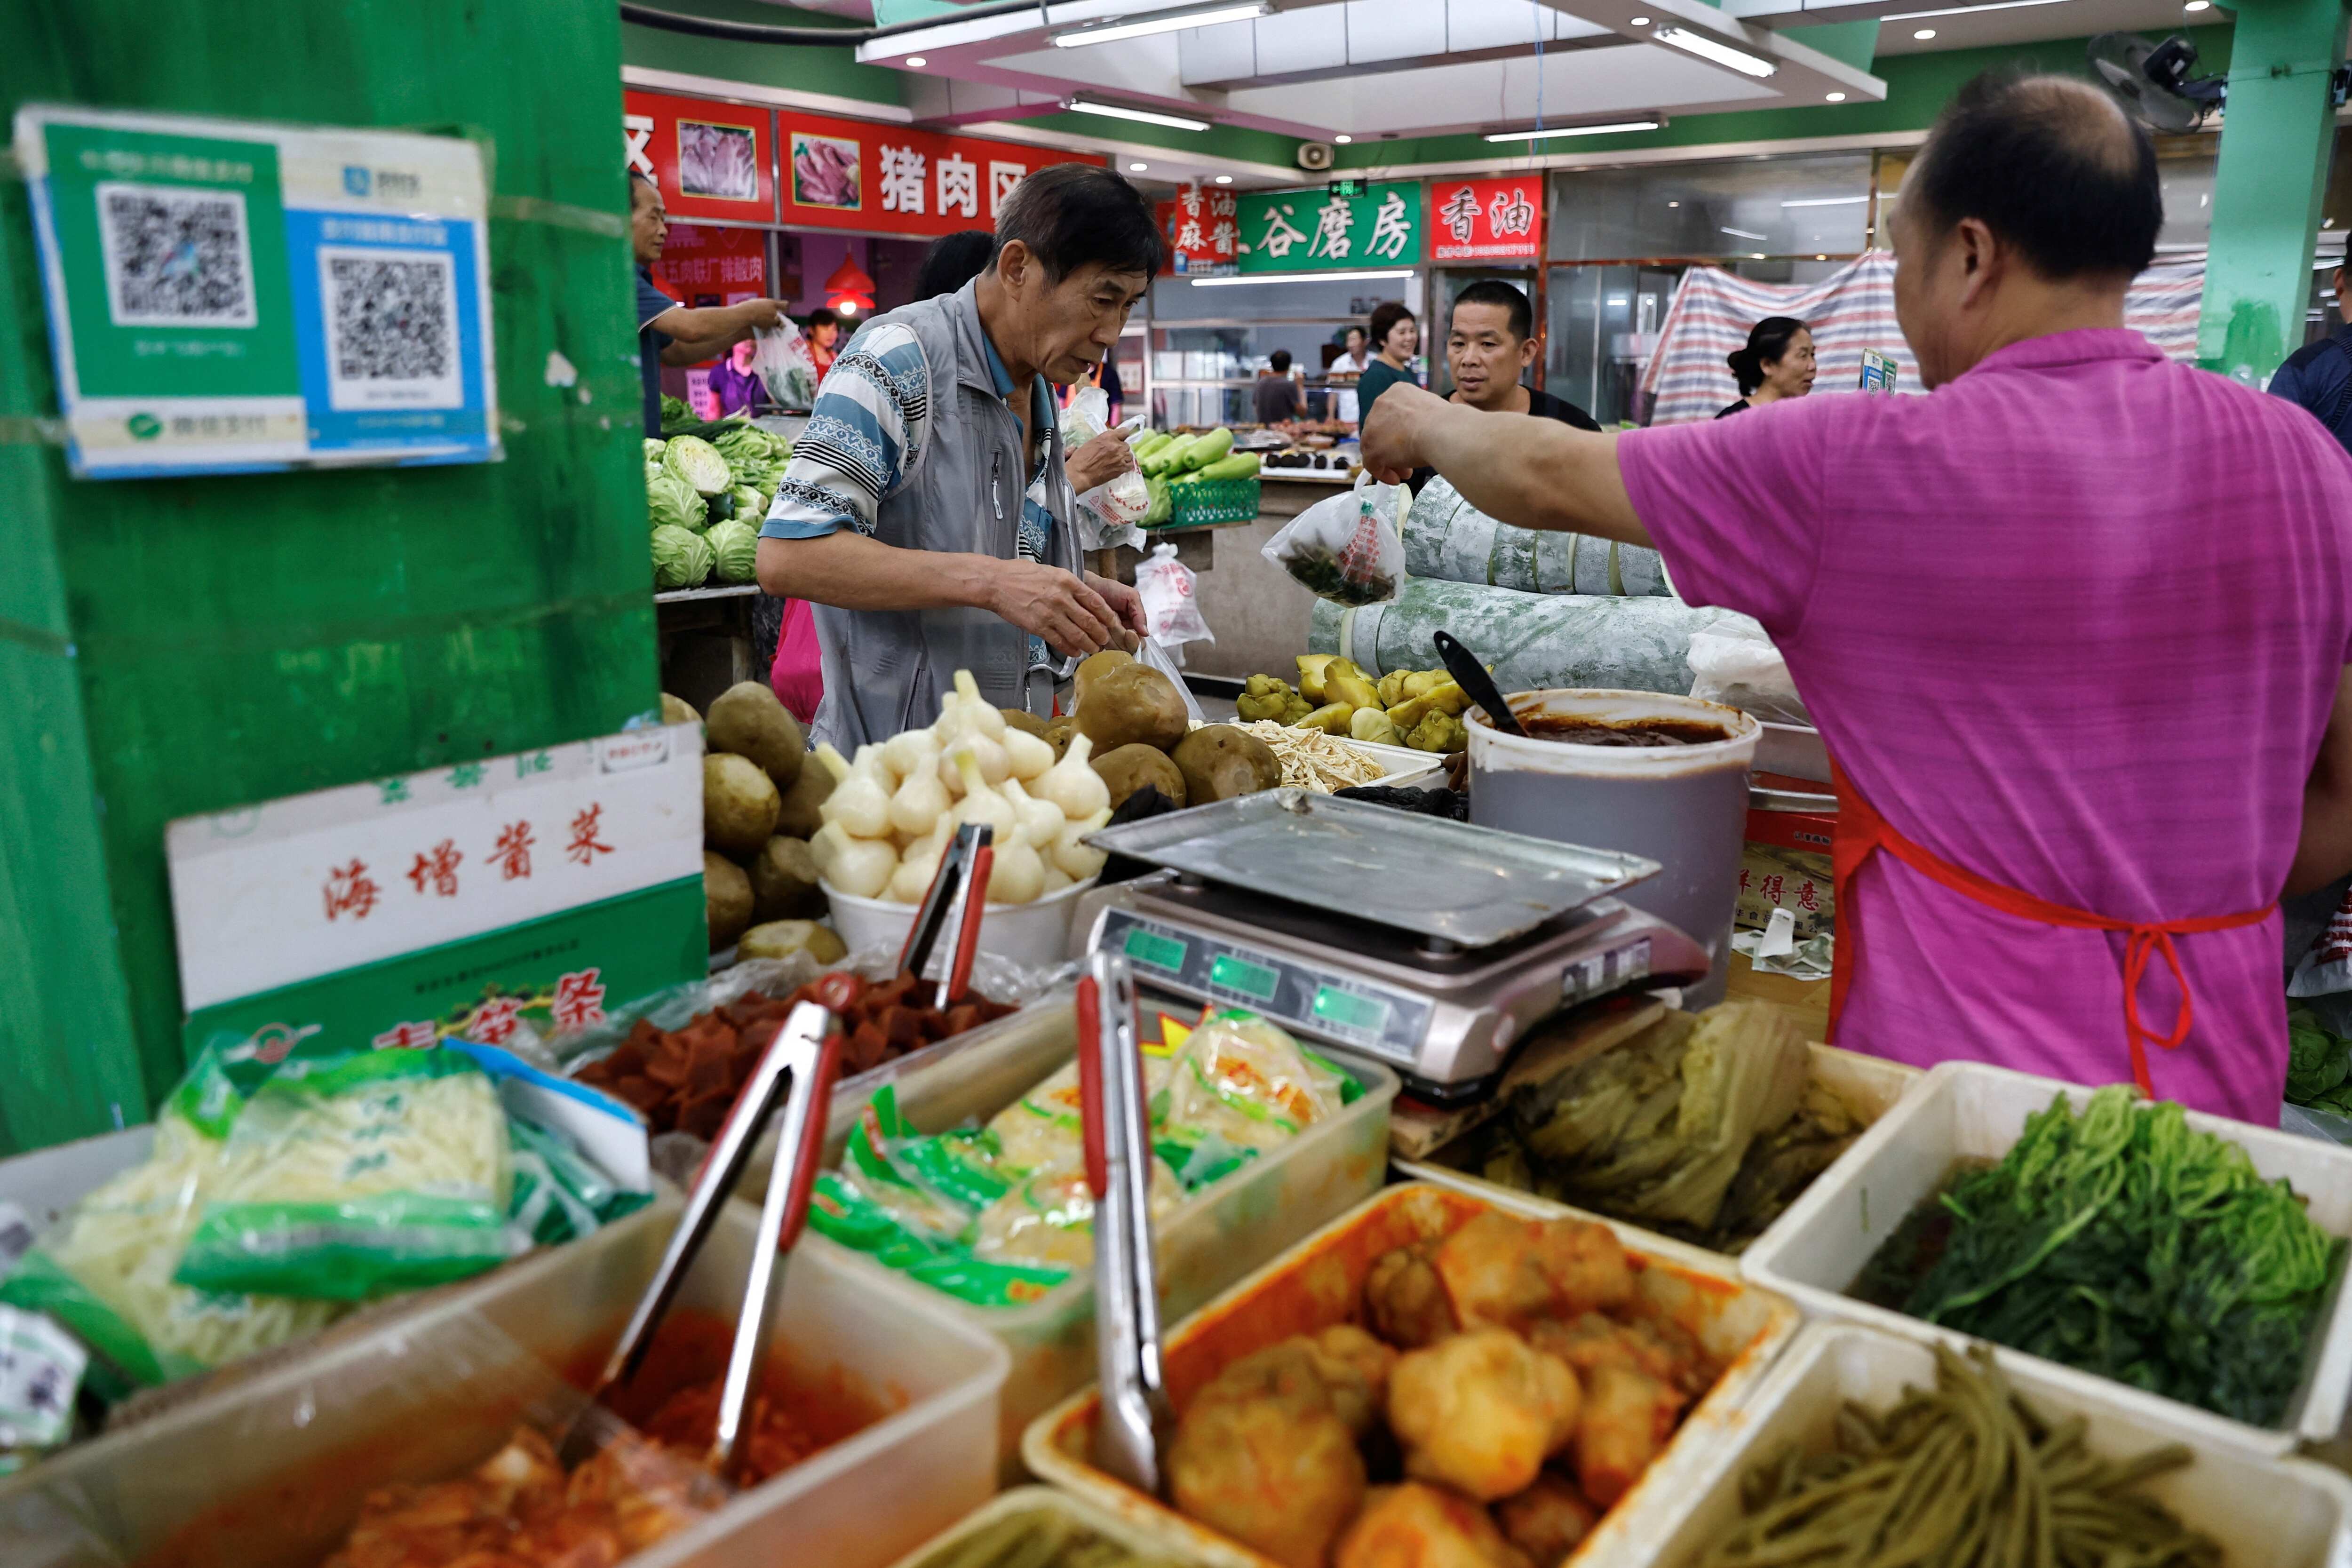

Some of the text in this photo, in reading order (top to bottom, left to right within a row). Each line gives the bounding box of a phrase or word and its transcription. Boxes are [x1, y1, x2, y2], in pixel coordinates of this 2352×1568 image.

[879, 143, 1026, 220] 猪肉区
[1438, 185, 1535, 245] 香油
[1237, 191, 1413, 261] 谷磨房
